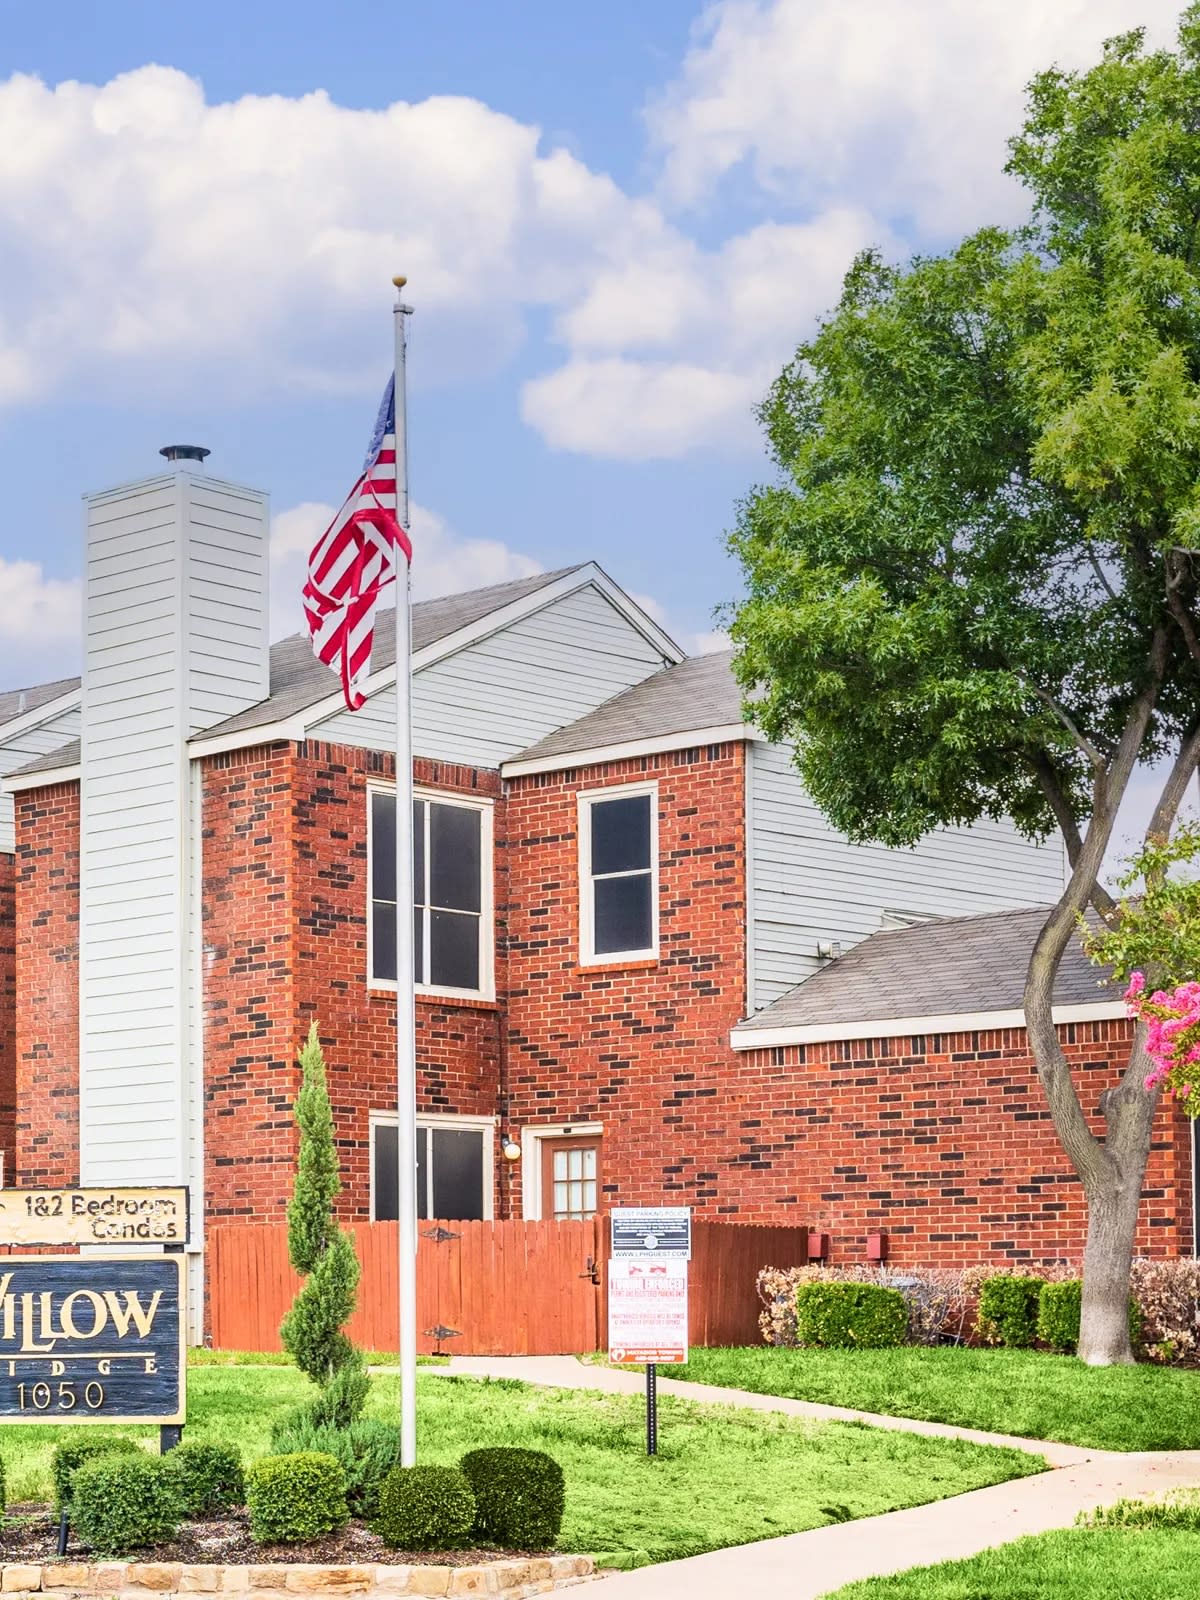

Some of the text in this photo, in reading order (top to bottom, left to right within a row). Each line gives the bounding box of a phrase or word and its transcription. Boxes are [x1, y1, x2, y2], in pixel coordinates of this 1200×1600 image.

[24, 1194, 177, 1217] 1&2 Bedroom
[91, 1217, 177, 1239] Condos
[17, 1382, 104, 1410] 1050
